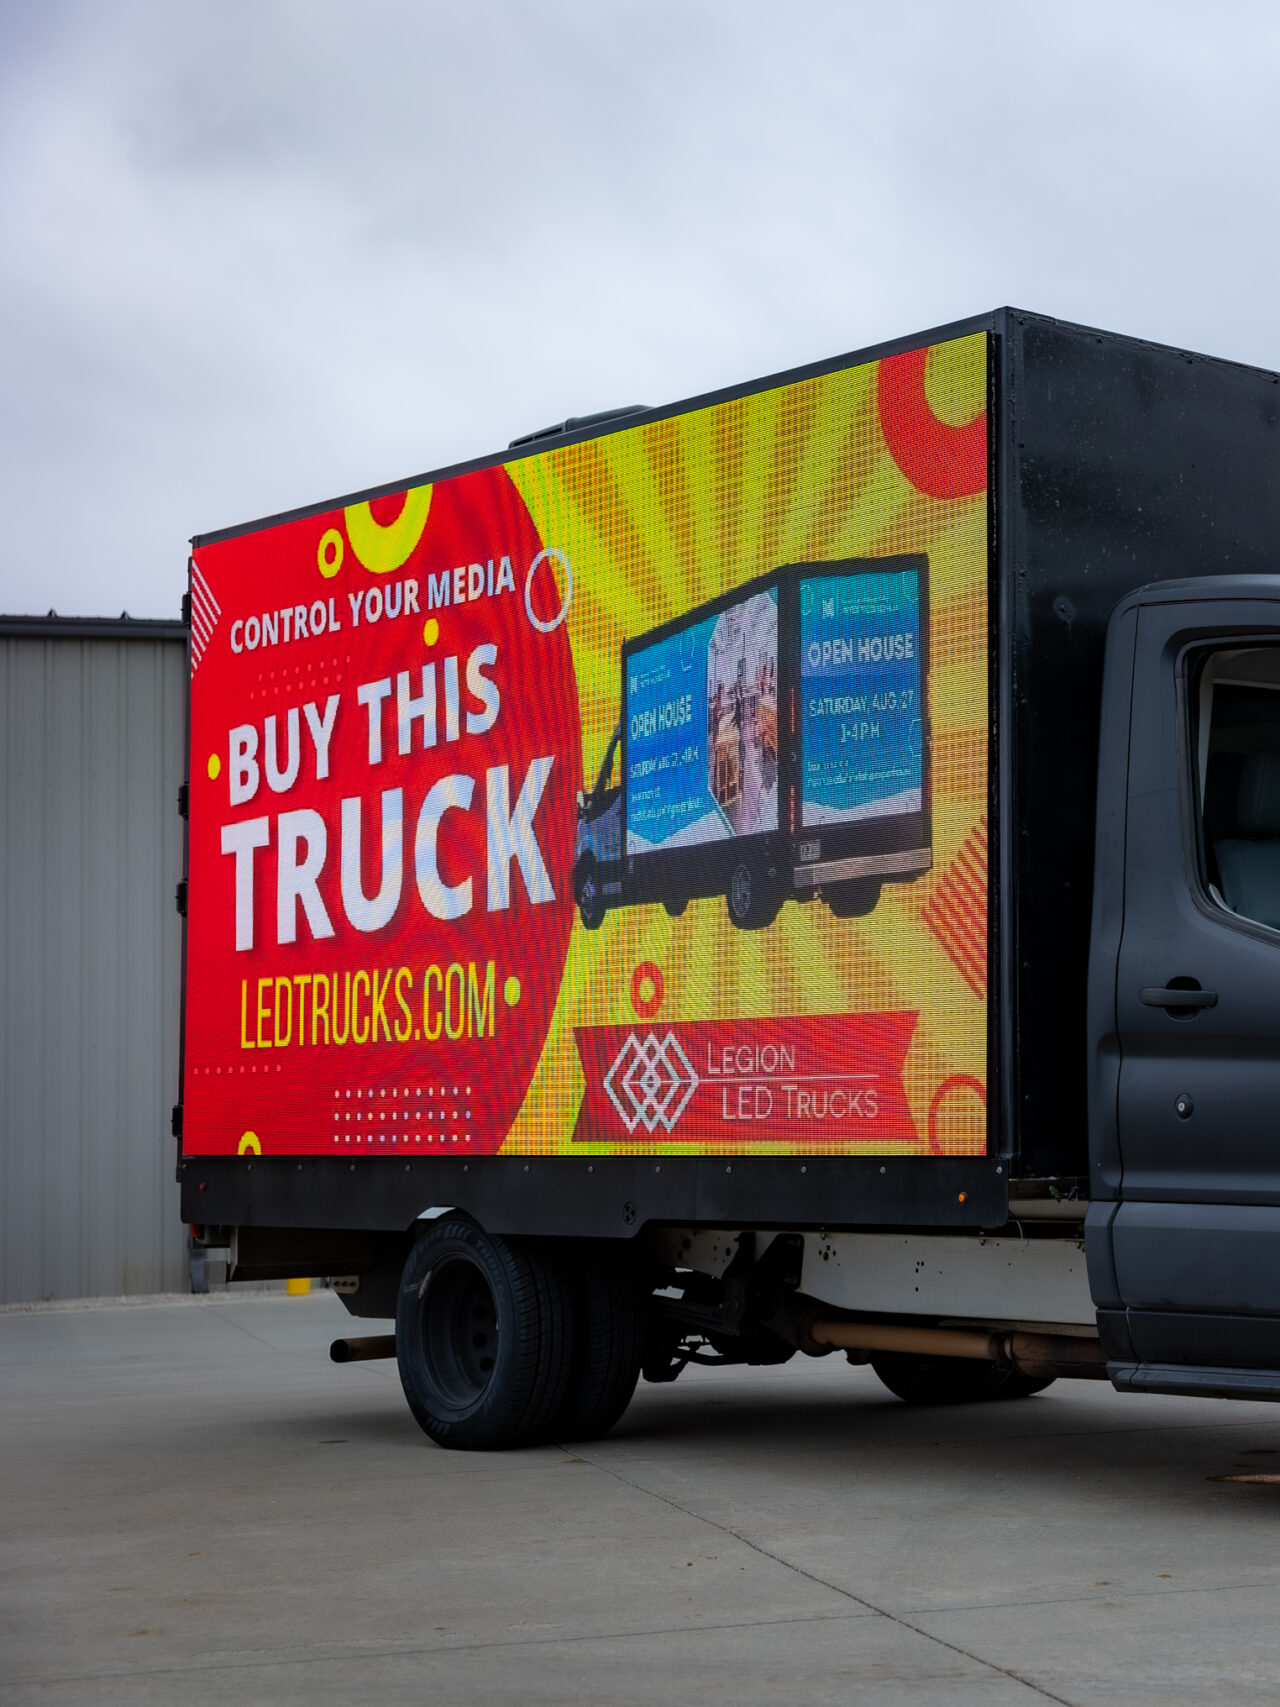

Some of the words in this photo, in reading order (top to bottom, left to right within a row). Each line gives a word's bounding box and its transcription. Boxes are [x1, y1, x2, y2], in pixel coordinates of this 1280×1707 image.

[230, 598, 341, 654] CONTROL
[348, 577, 420, 627] YOUR
[427, 556, 516, 610] MEDIA
[807, 638, 853, 668] OPEN
[858, 632, 914, 662] HOUSE
[228, 694, 341, 807] BUY
[357, 643, 500, 765] THIS
[220, 754, 556, 952] TRUCK
[240, 960, 496, 1049] LEDTRUCKS.COM
[722, 1086, 773, 1120] LED
